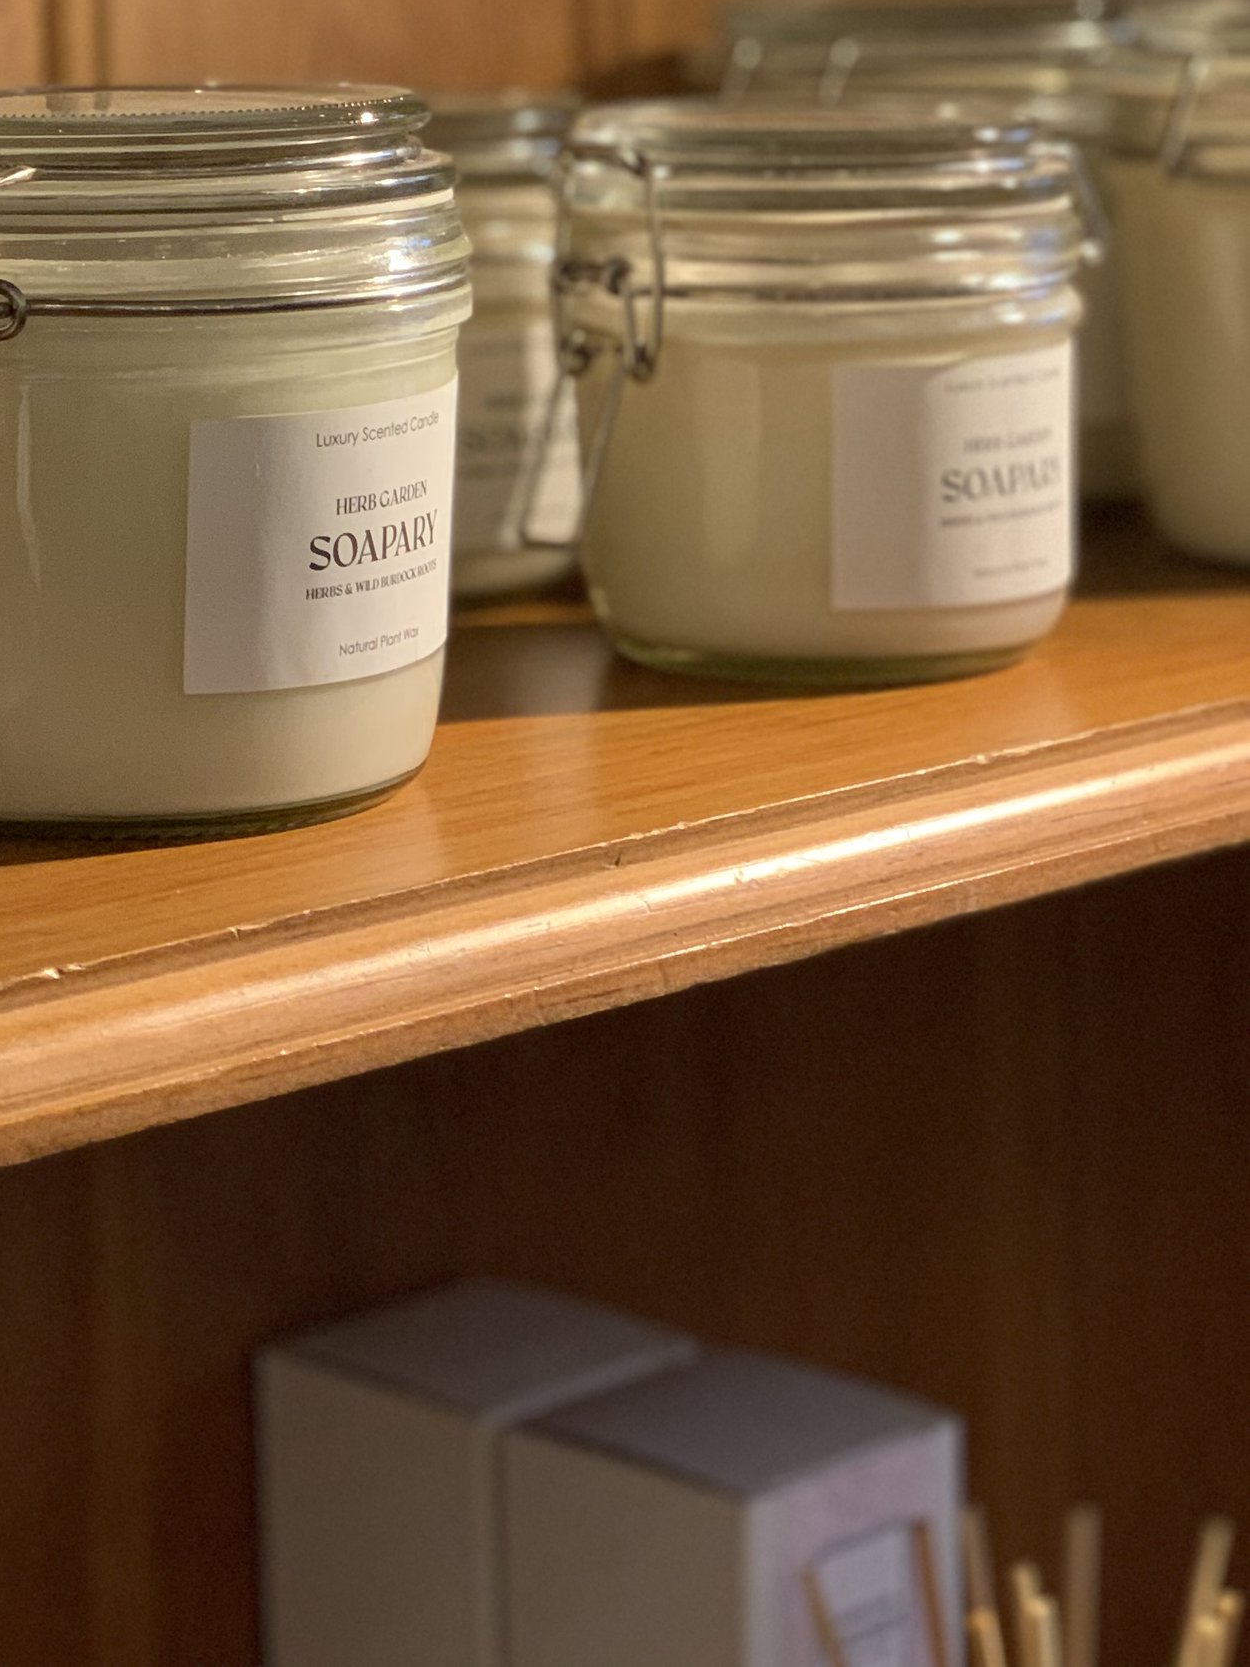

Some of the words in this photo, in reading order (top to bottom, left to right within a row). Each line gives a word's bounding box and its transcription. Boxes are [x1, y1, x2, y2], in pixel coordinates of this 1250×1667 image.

[316, 431, 360, 448] Luxury
[362, 419, 409, 442] Scented
[410, 411, 440, 432] Candle
[336, 493, 377, 516] HERB
[379, 478, 428, 508] GARDEN
[309, 508, 438, 571] SOAPARY
[305, 585, 343, 601] HERBS
[344, 583, 353, 595] &
[355, 578, 380, 593] WILD
[380, 566, 417, 590] BURDOCK
[338, 637, 378, 657] Natural
[380, 630, 401, 648] Plant
[403, 627, 420, 640] Wax
